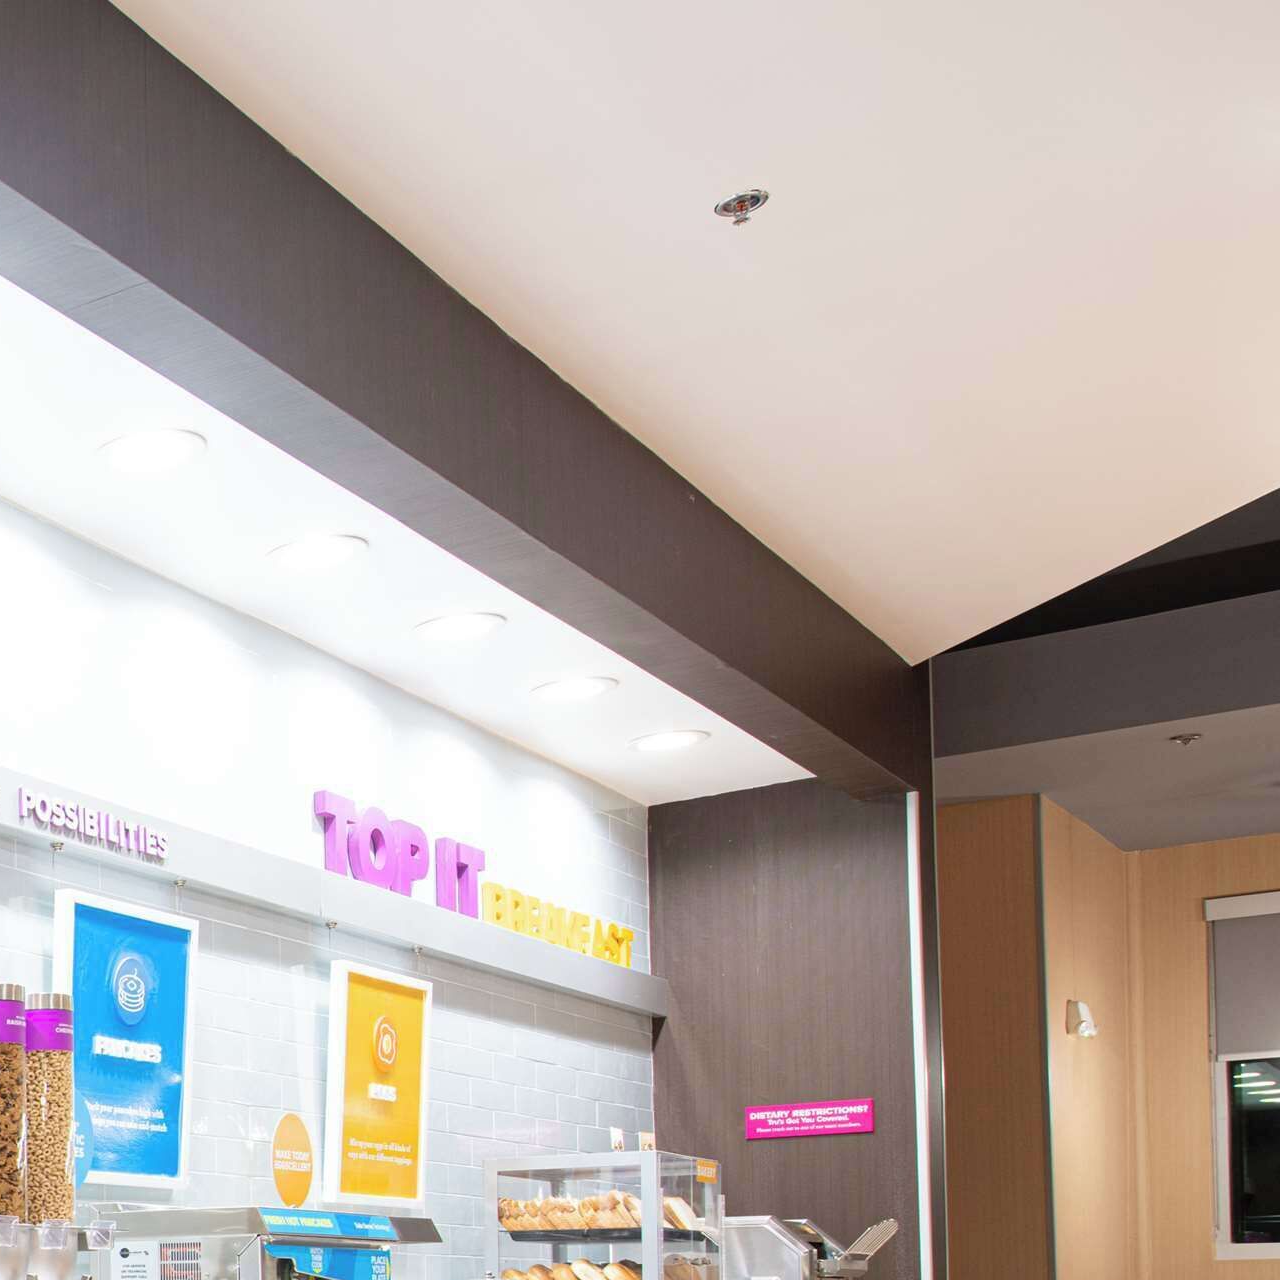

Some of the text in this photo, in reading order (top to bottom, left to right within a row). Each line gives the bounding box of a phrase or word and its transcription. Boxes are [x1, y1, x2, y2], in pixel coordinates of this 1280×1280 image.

[18, 786, 169, 858] POSSIBILITIES
[313, 789, 486, 919] TOP IT
[749, 1105, 868, 1120] DIETARY RESTRICTIONS?
[372, 1265, 385, 1274] YOUR
